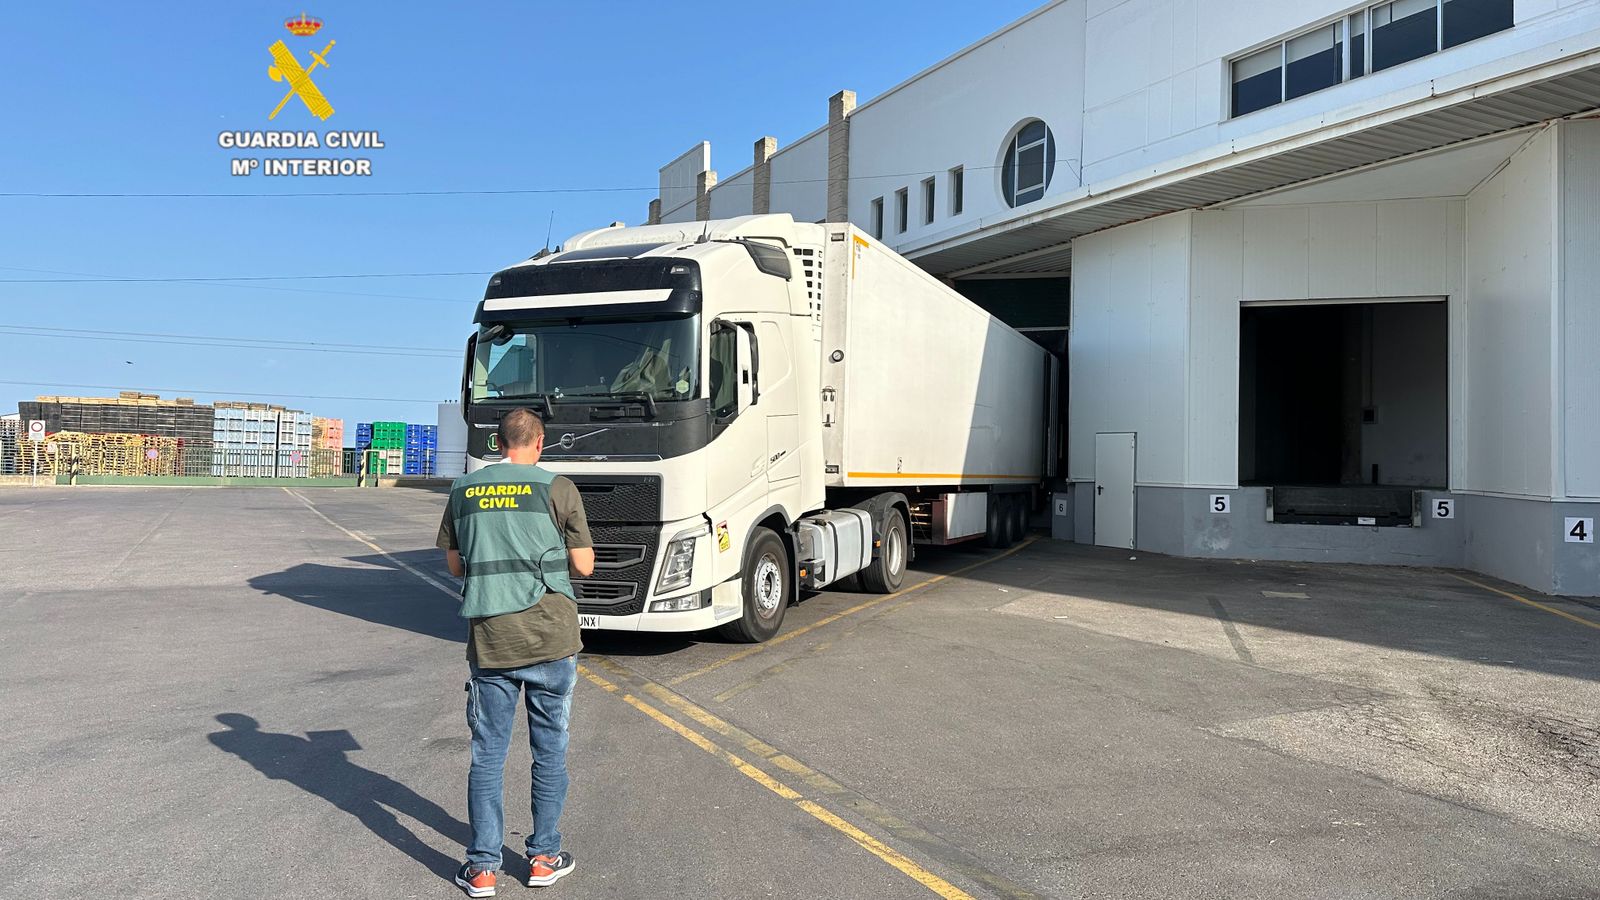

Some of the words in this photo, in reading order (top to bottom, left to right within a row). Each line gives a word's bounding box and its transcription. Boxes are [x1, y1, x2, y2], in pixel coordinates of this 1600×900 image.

[465, 484, 533, 498] GUARDIA
[479, 497, 519, 509] CIVIL
[1058, 503, 1064, 513] 6
[1214, 496, 1226, 512] 5
[1437, 501, 1450, 517] 5
[1569, 520, 1587, 541] 4
